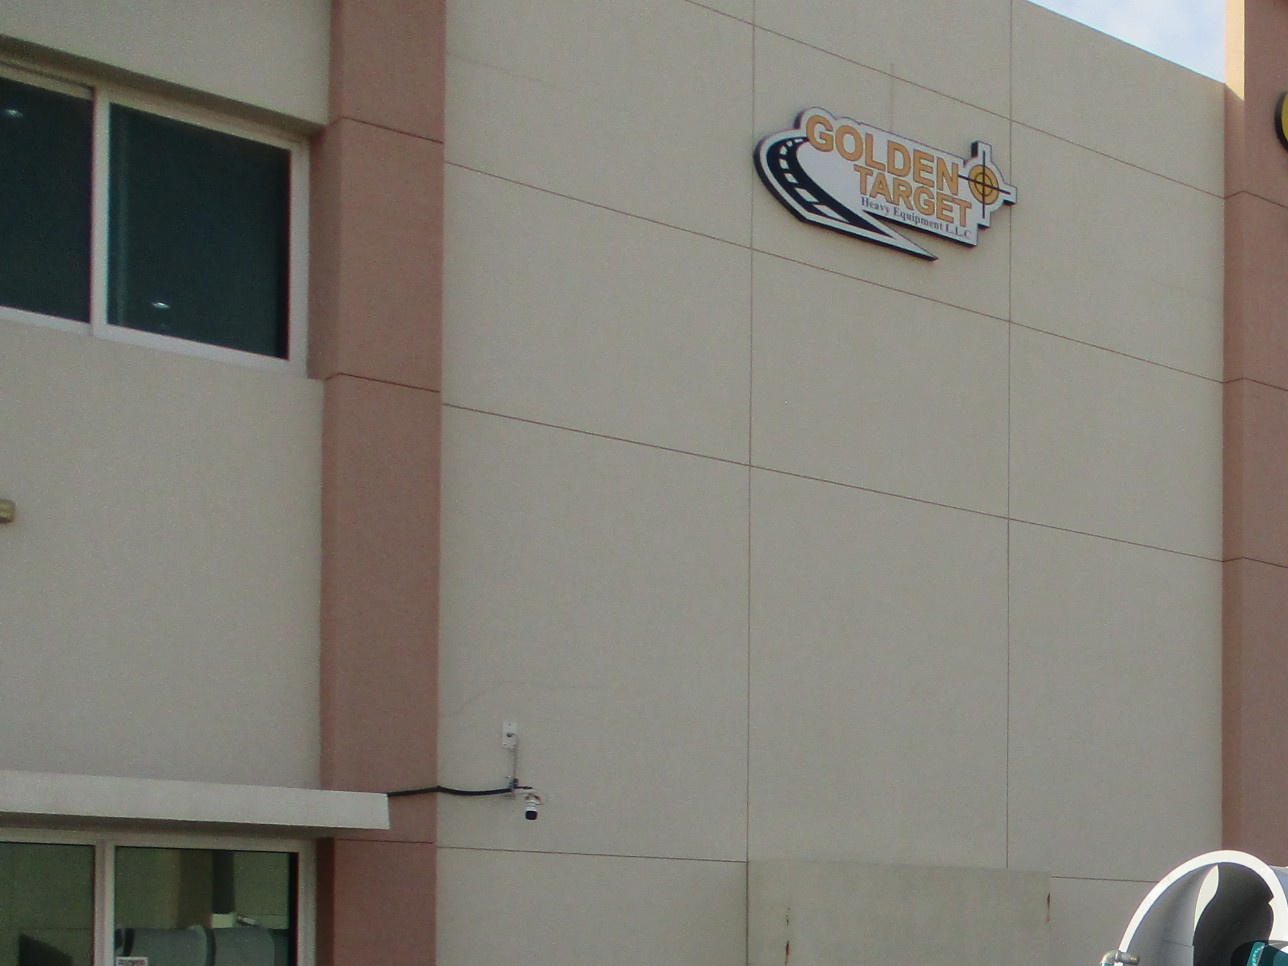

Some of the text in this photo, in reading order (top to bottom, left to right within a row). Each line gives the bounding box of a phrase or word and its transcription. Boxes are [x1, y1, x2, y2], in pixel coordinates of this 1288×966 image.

[805, 114, 960, 195] GOLDEN
[853, 164, 973, 228] TARGET
[860, 196, 890, 216] Heavy
[893, 207, 943, 230] Equipment
